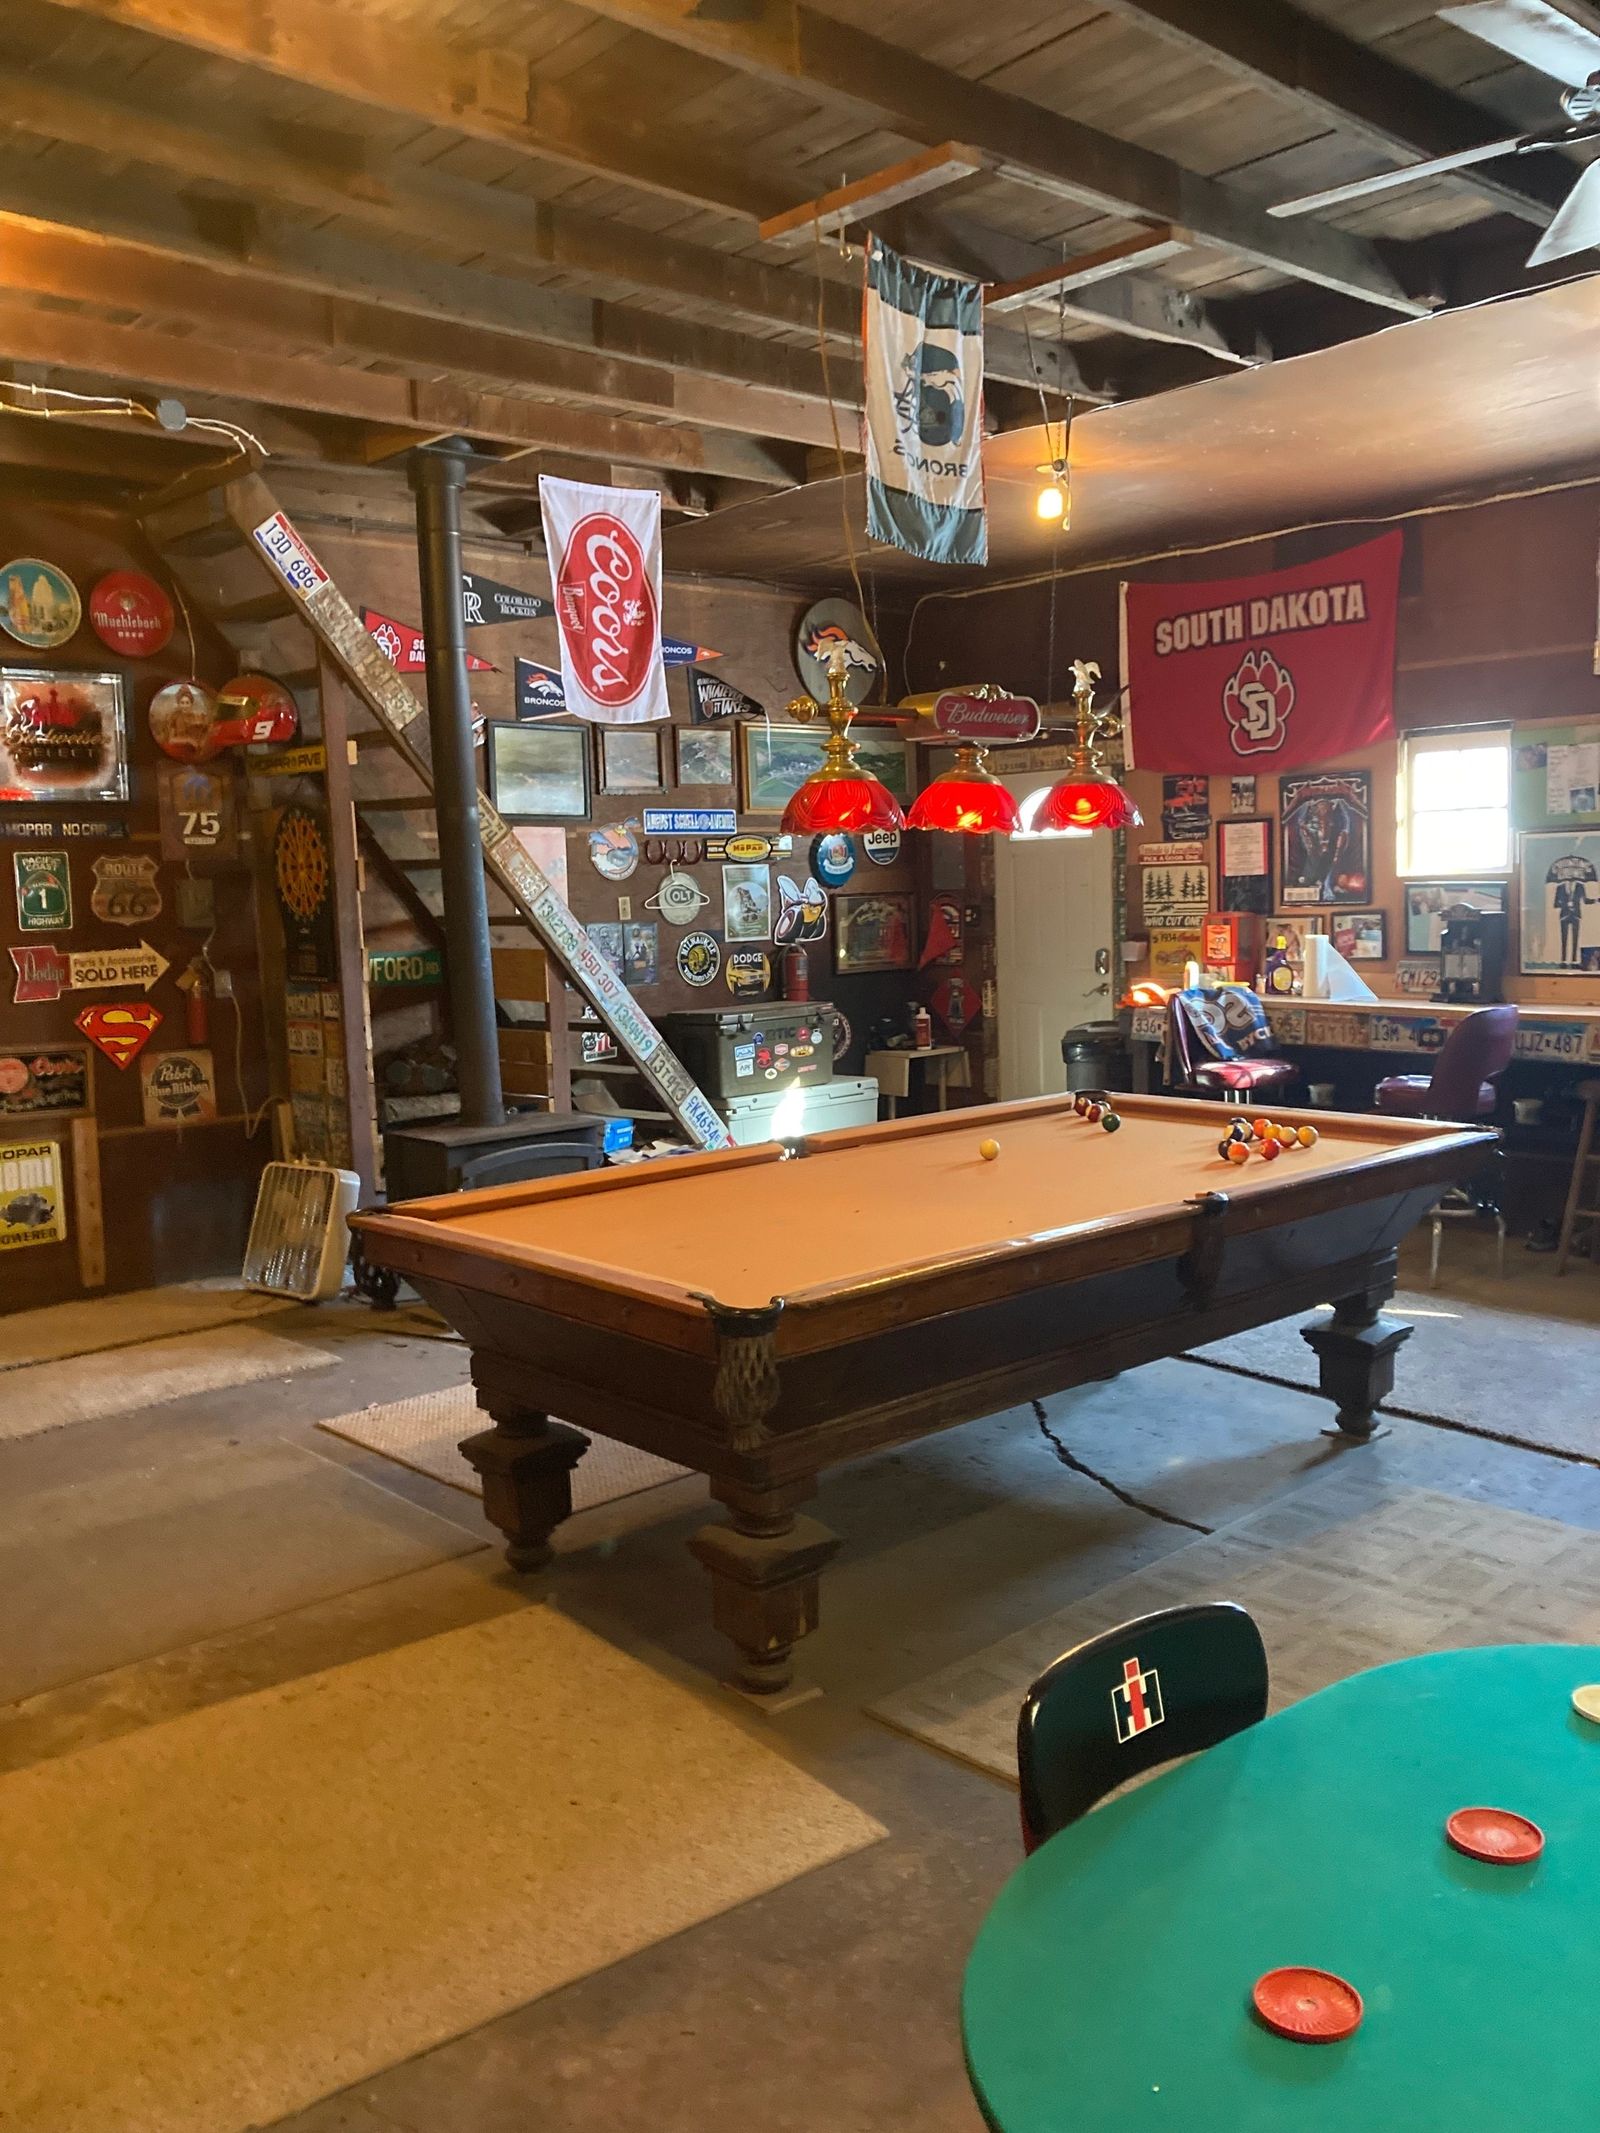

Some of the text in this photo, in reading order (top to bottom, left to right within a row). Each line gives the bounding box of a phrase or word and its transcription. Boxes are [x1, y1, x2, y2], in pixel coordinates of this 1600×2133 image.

[265, 522, 317, 589] 13D 686
[494, 593, 541, 607] COLORADO
[562, 586, 585, 631] Banquet
[500, 603, 537, 617] ROCKIES
[586, 530, 633, 691] Coors
[1156, 583, 1366, 654] SOUTH DAKOTA
[662, 646, 693, 655] ONCOS
[524, 696, 566, 707] BRONCOS
[945, 701, 1030, 724] Budweiser
[1240, 682, 1277, 741] SD
[252, 721, 274, 739] 9
[178, 812, 220, 835] 75
[868, 831, 897, 845] Jeep
[104, 862, 147, 875] ROUTE
[39, 888, 47, 910] 1
[108, 893, 148, 917] 66
[28, 916, 65, 926] HIGHWAY
[1145, 916, 1201, 926] WHO CUT ONE
[681, 936, 717, 956] MILWAUKEE
[733, 953, 763, 964] DODGE
[75, 965, 158, 983] SOLD HERE
[369, 956, 423, 981] FORD
[159, 1063, 193, 1081] Pabst
[0, 1145, 51, 1160] OPAR
[0, 1228, 57, 1245] OWERED
